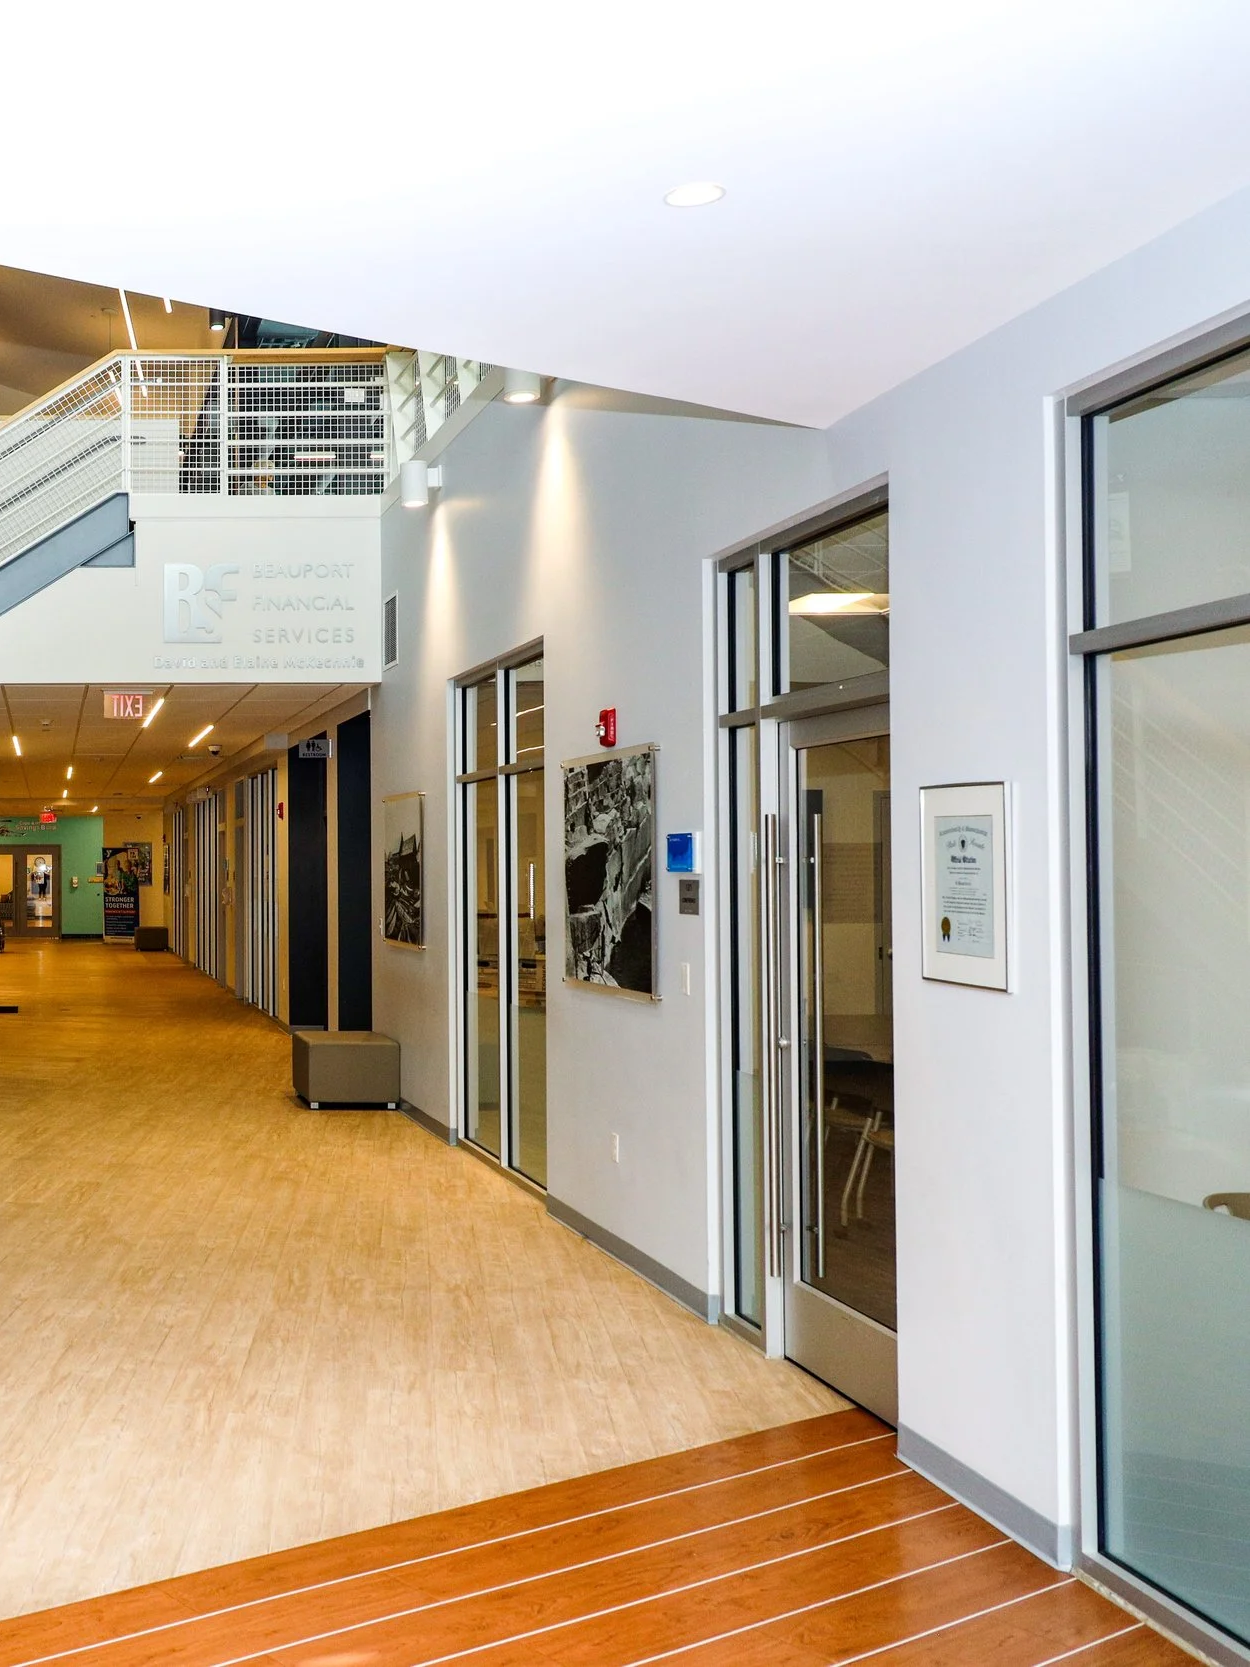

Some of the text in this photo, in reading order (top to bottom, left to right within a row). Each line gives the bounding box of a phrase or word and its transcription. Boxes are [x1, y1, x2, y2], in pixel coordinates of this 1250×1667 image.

[252, 564, 355, 579] BEAUPORT
[252, 597, 355, 612] FINANCIAL
[252, 629, 355, 644] SERVICES
[153, 656, 196, 670] David
[201, 656, 228, 670] and
[232, 656, 278, 670] Elaine
